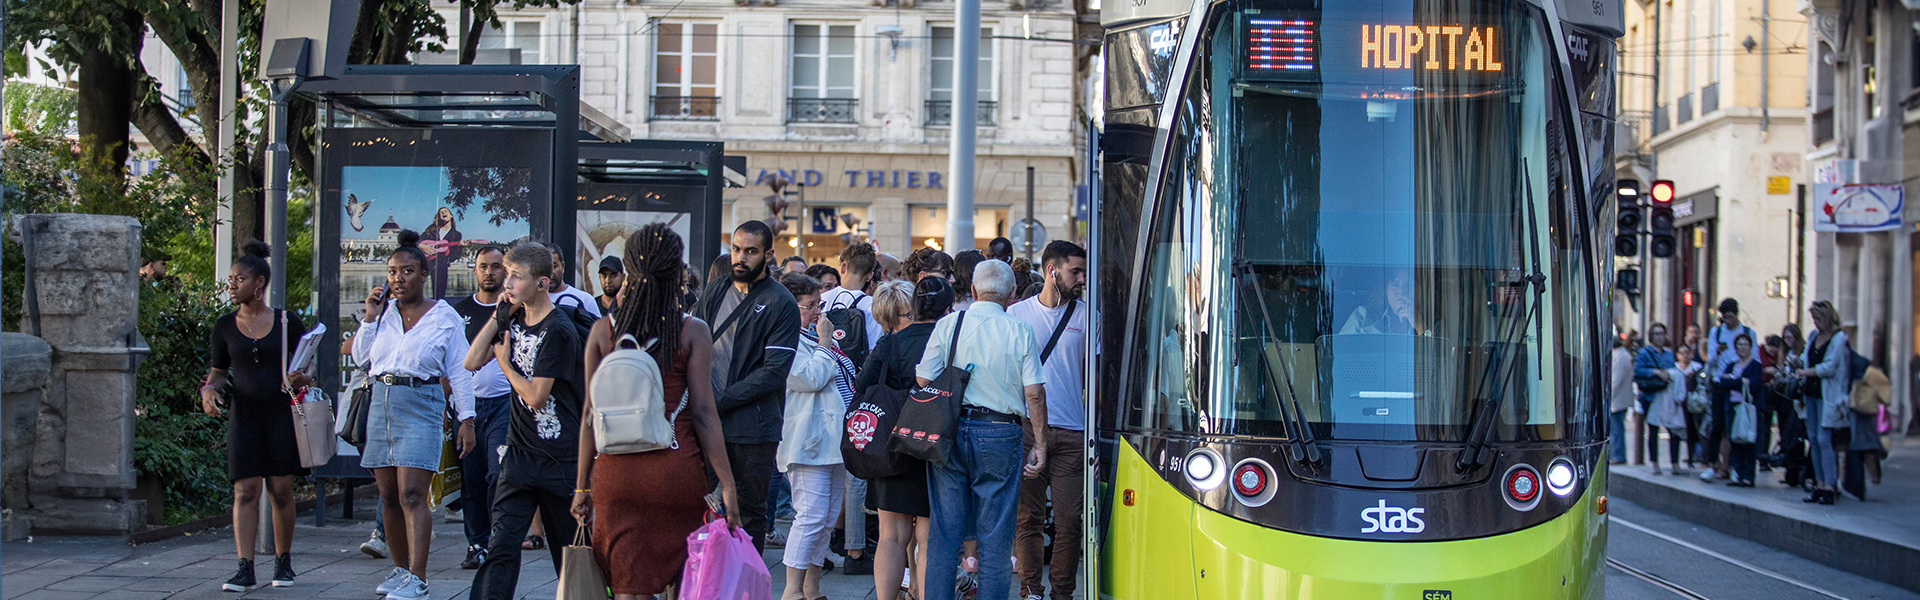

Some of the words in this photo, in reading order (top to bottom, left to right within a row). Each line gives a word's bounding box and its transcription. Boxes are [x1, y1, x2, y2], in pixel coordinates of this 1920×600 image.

[1592, 0, 1604, 16] 951
[1150, 27, 1179, 54] CAF
[1361, 24, 1502, 71] HOPITAL
[1568, 34, 1588, 62] CAF
[869, 403, 886, 419] CAFE
[1169, 456, 1183, 472] 951
[1360, 498, 1426, 534] stas
